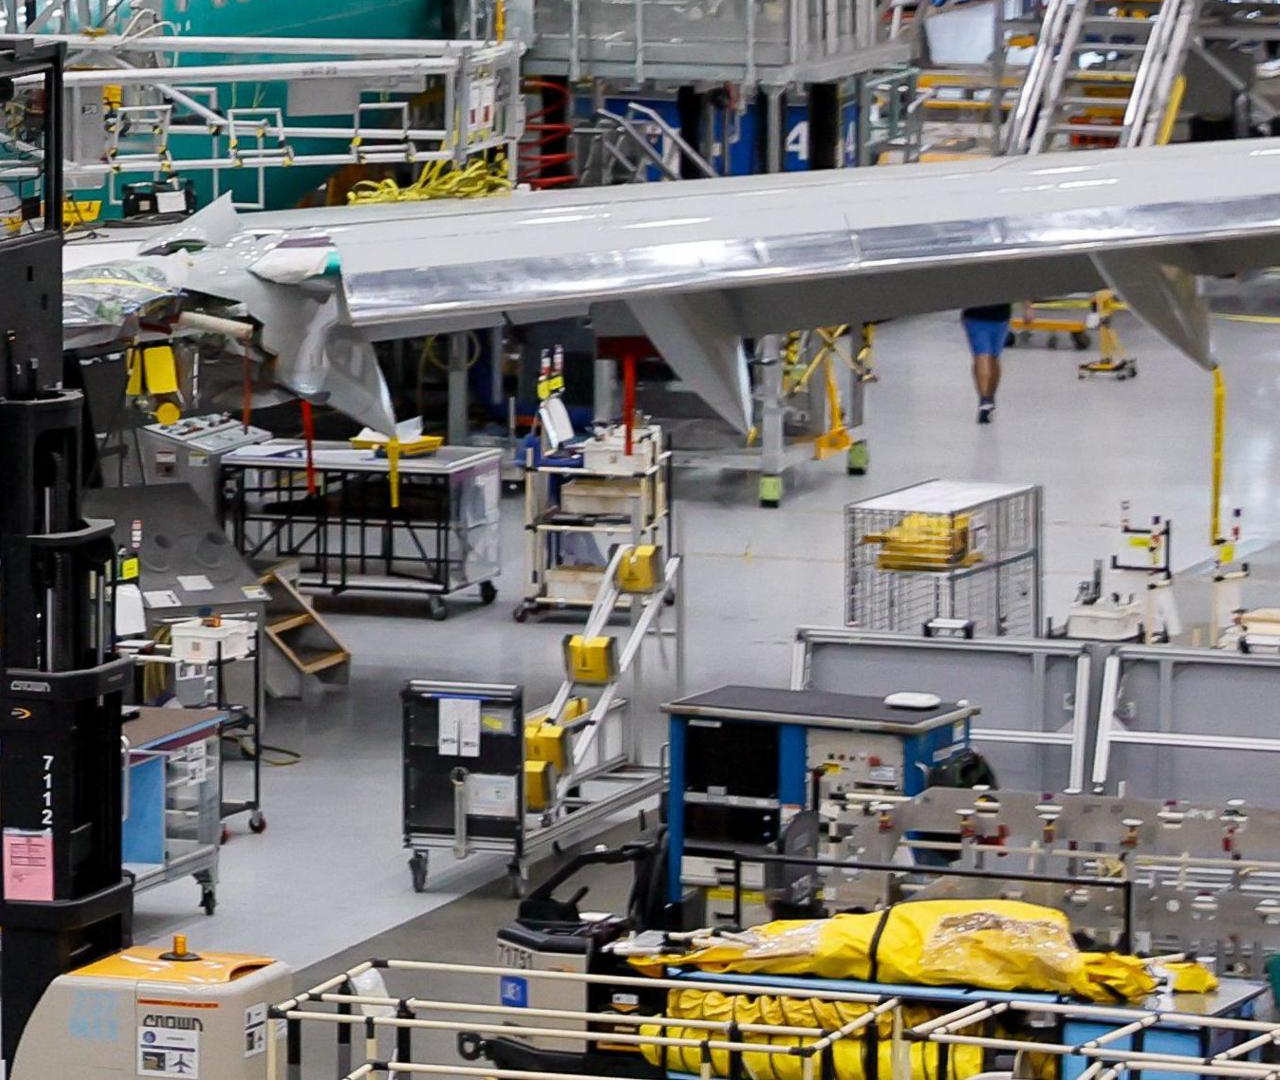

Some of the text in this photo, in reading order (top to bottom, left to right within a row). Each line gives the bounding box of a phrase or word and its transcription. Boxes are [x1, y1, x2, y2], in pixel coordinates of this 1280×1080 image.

[11, 680, 51, 692] CROWN
[41, 756, 54, 824] 7112
[143, 1014, 203, 1032] CROWN
